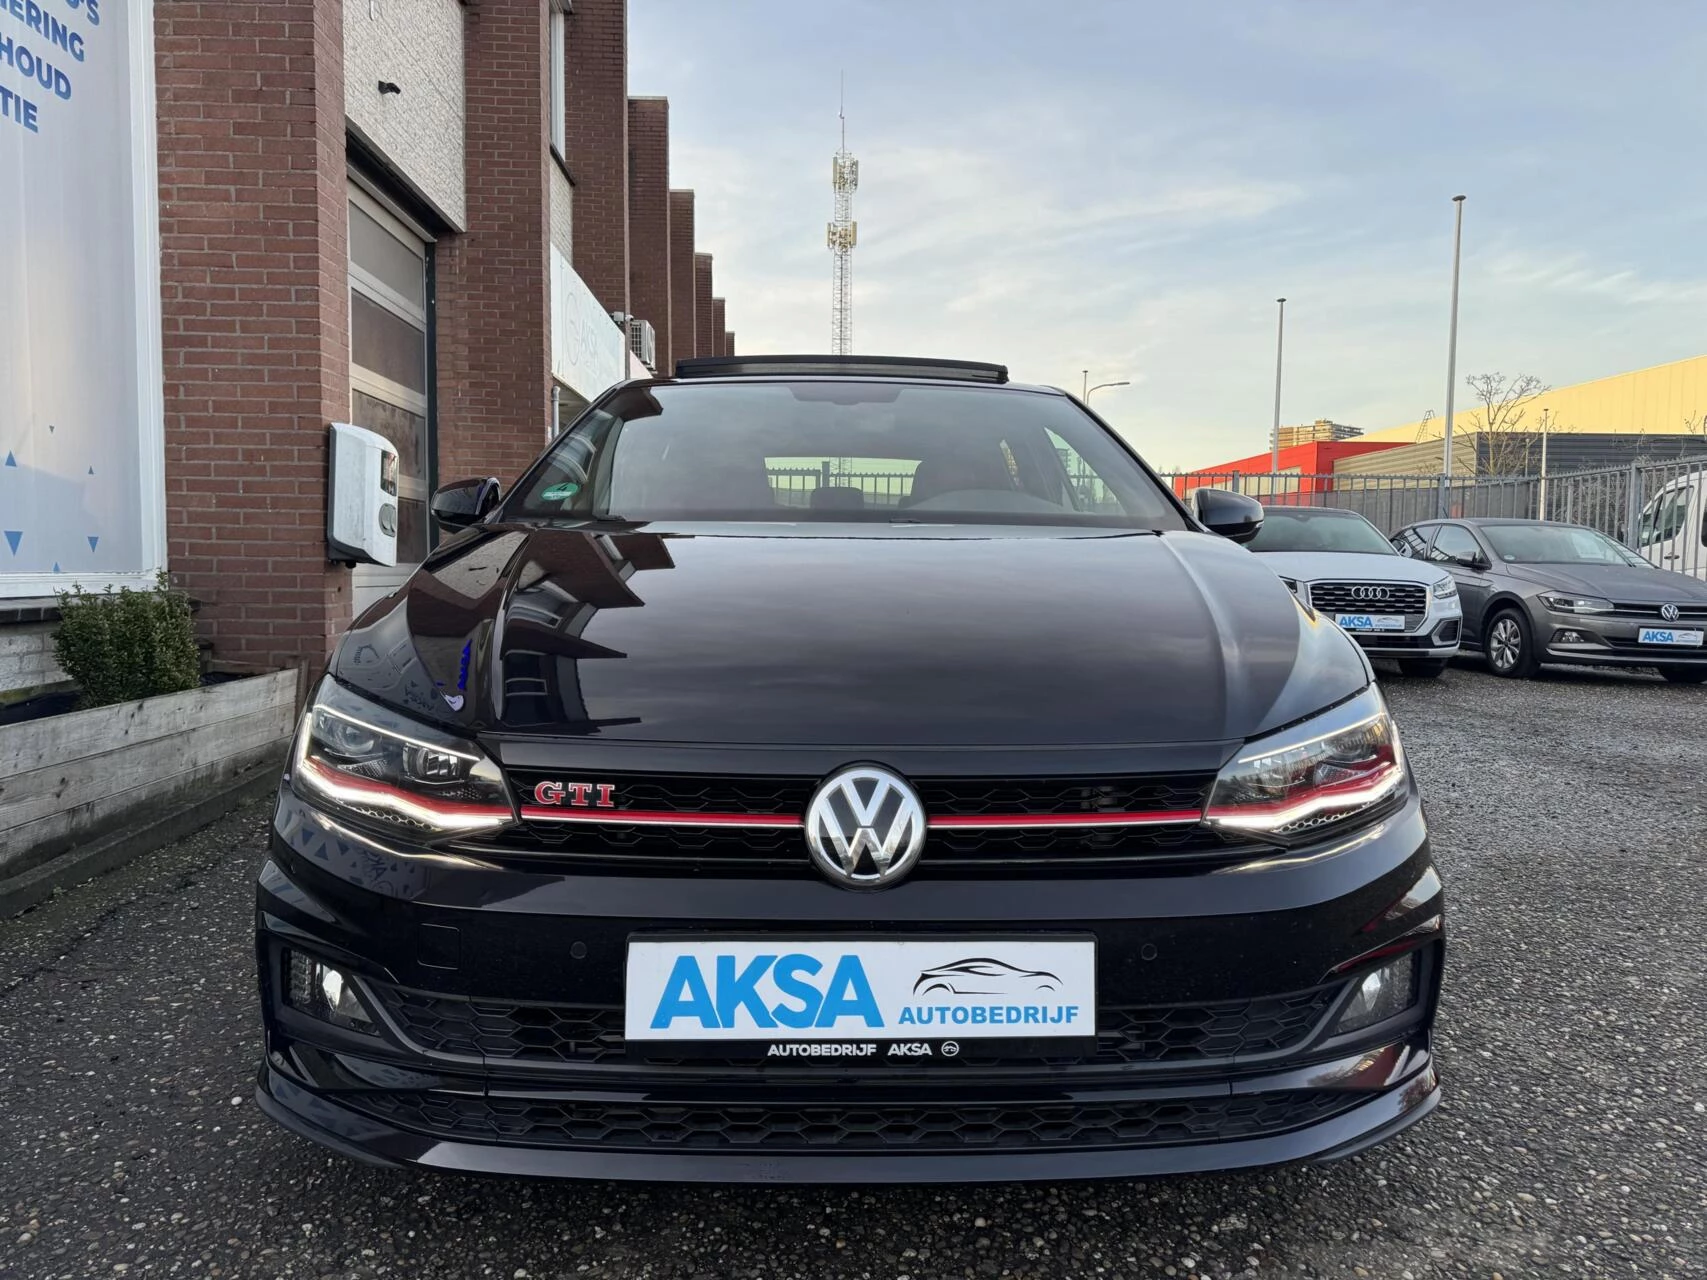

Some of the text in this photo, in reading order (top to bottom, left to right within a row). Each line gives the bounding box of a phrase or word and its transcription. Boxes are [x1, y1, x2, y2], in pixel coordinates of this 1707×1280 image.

[1339, 616, 1373, 627] AKSA
[1643, 631, 1674, 642] AKSA
[534, 780, 616, 807] GTI
[649, 953, 885, 1029] AKSA
[898, 1005, 1079, 1025] AUTOBEDRIJF
[767, 1043, 932, 1056] AUTOBEDRIJF AKSA
